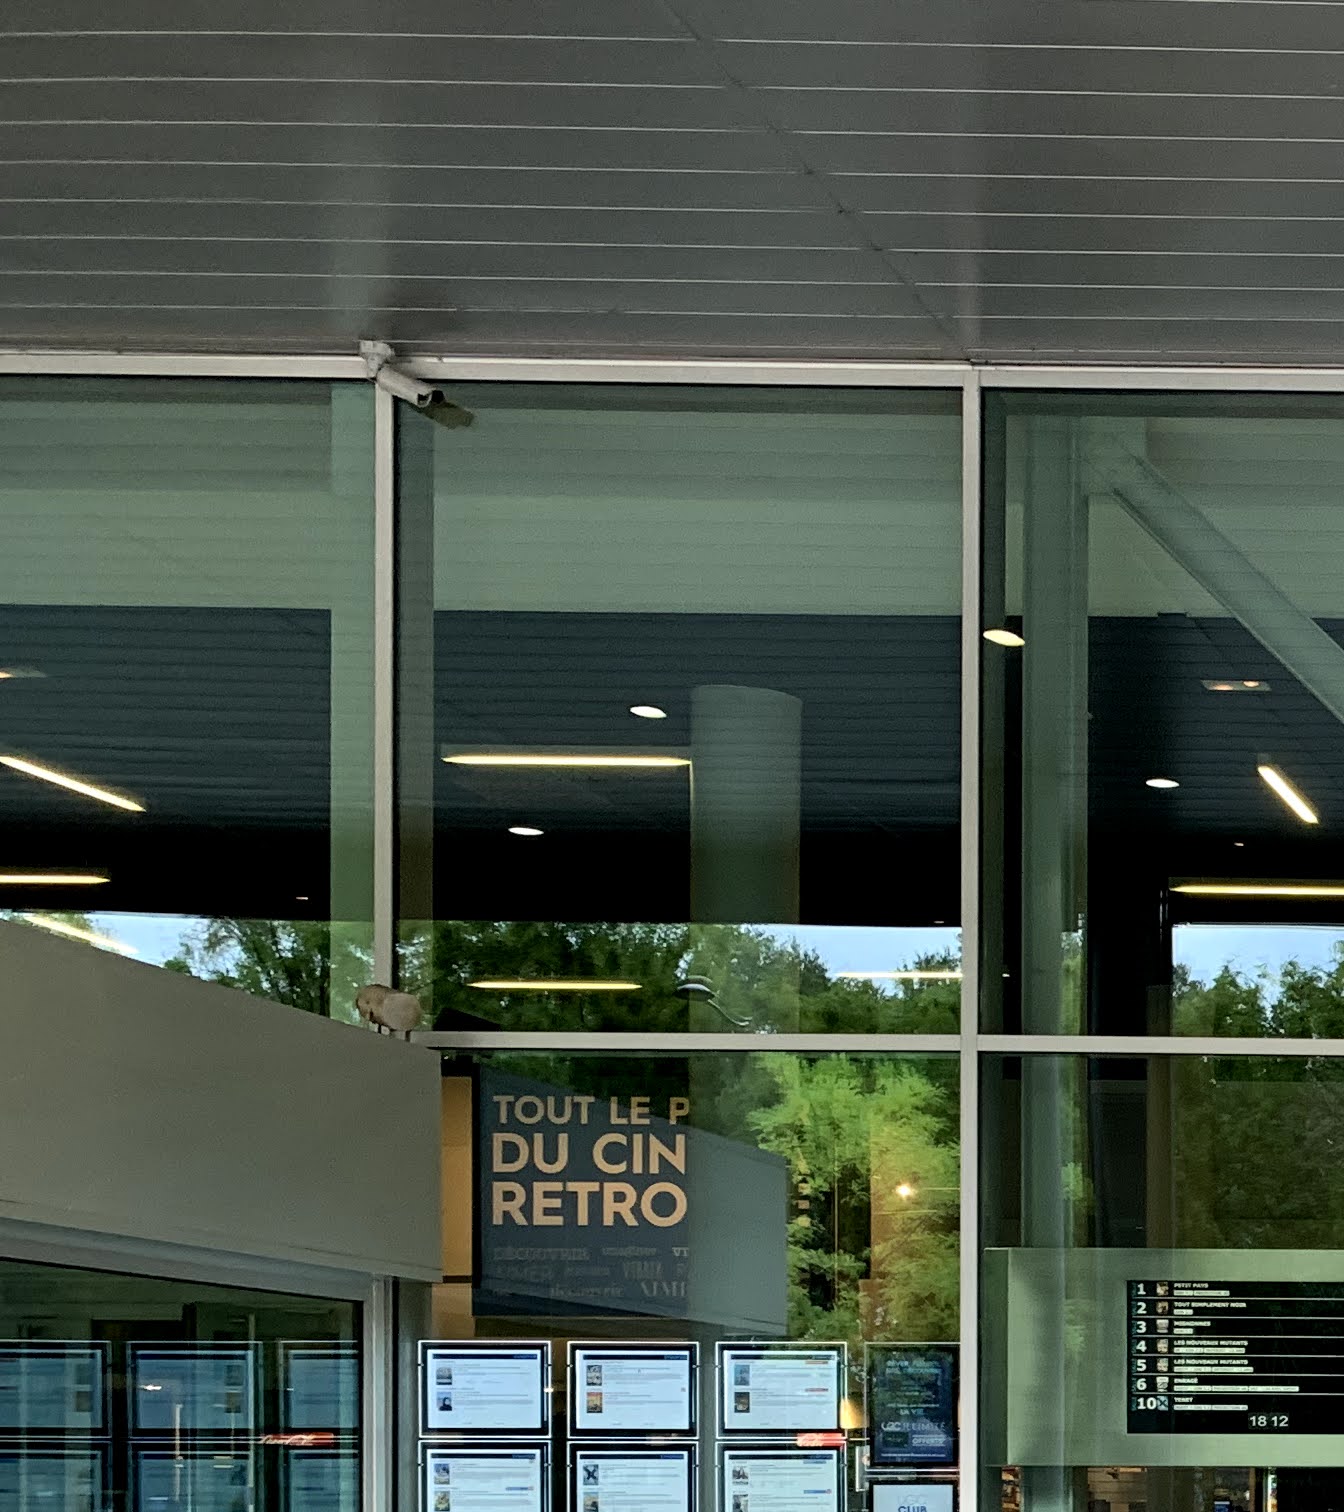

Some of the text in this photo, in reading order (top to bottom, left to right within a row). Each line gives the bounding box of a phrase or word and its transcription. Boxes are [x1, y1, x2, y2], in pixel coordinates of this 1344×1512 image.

[492, 1094, 595, 1126] TOUT
[609, 1094, 650, 1126] LE
[492, 1132, 687, 1174] DU CIN
[492, 1181, 688, 1227] RETRO
[1250, 1416, 1289, 1427] 18 12
